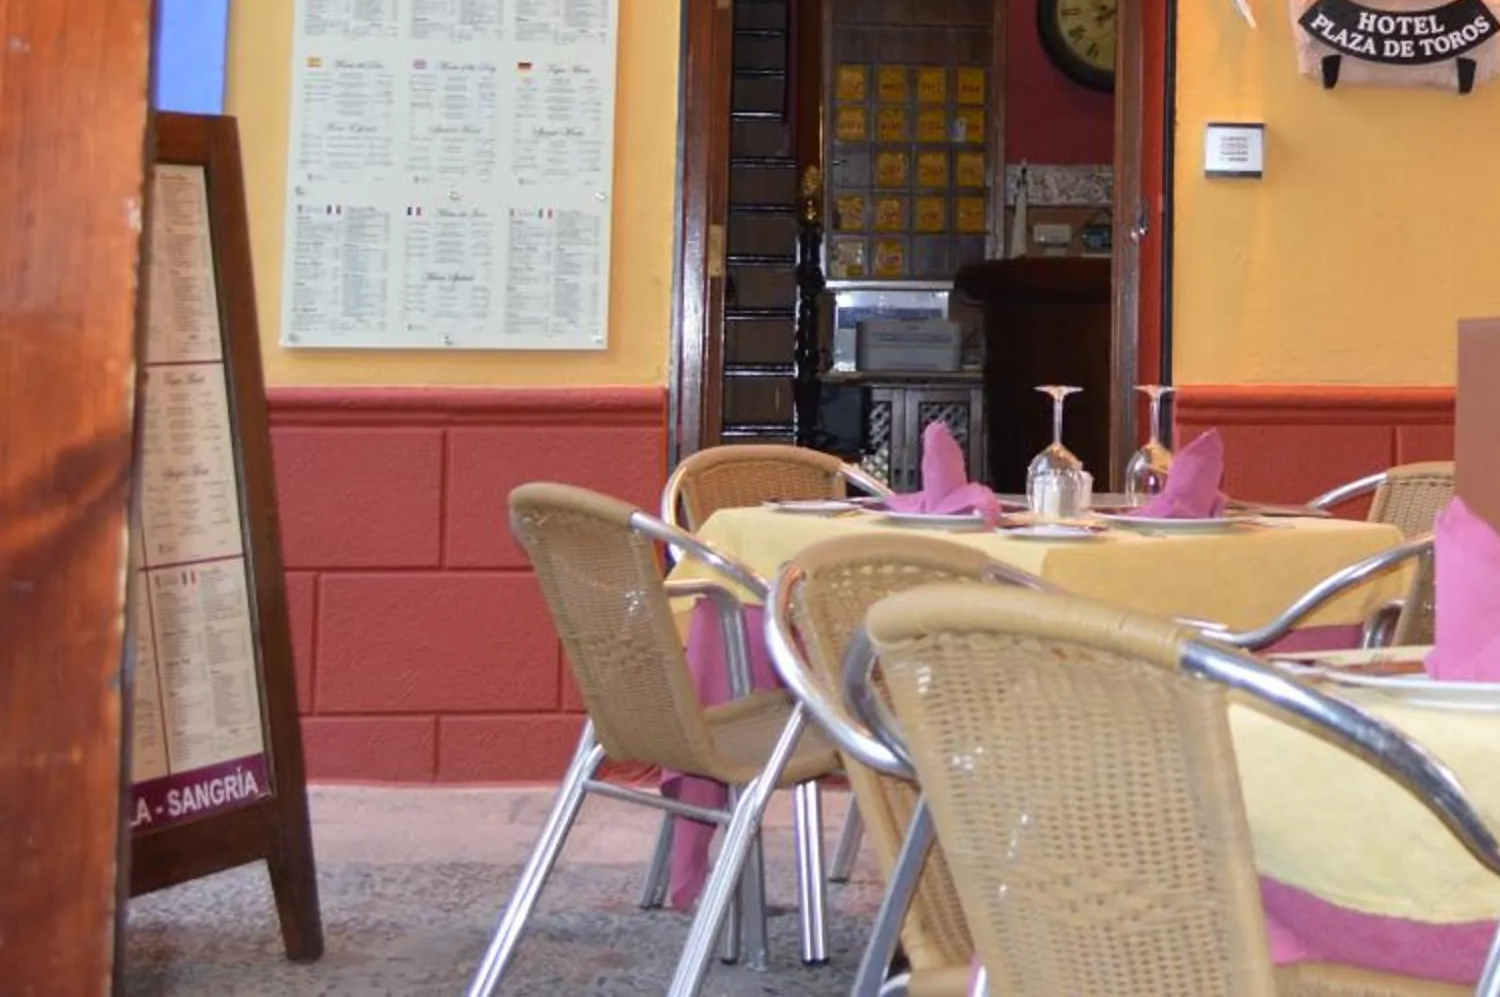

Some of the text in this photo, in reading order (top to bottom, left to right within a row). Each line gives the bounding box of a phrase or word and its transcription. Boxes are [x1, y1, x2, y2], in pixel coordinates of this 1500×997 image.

[1310, 13, 1491, 58] PLAZA DE TOROS
[1358, 13, 1445, 35] HOTEL
[166, 766, 260, 817] SANGRÍA
